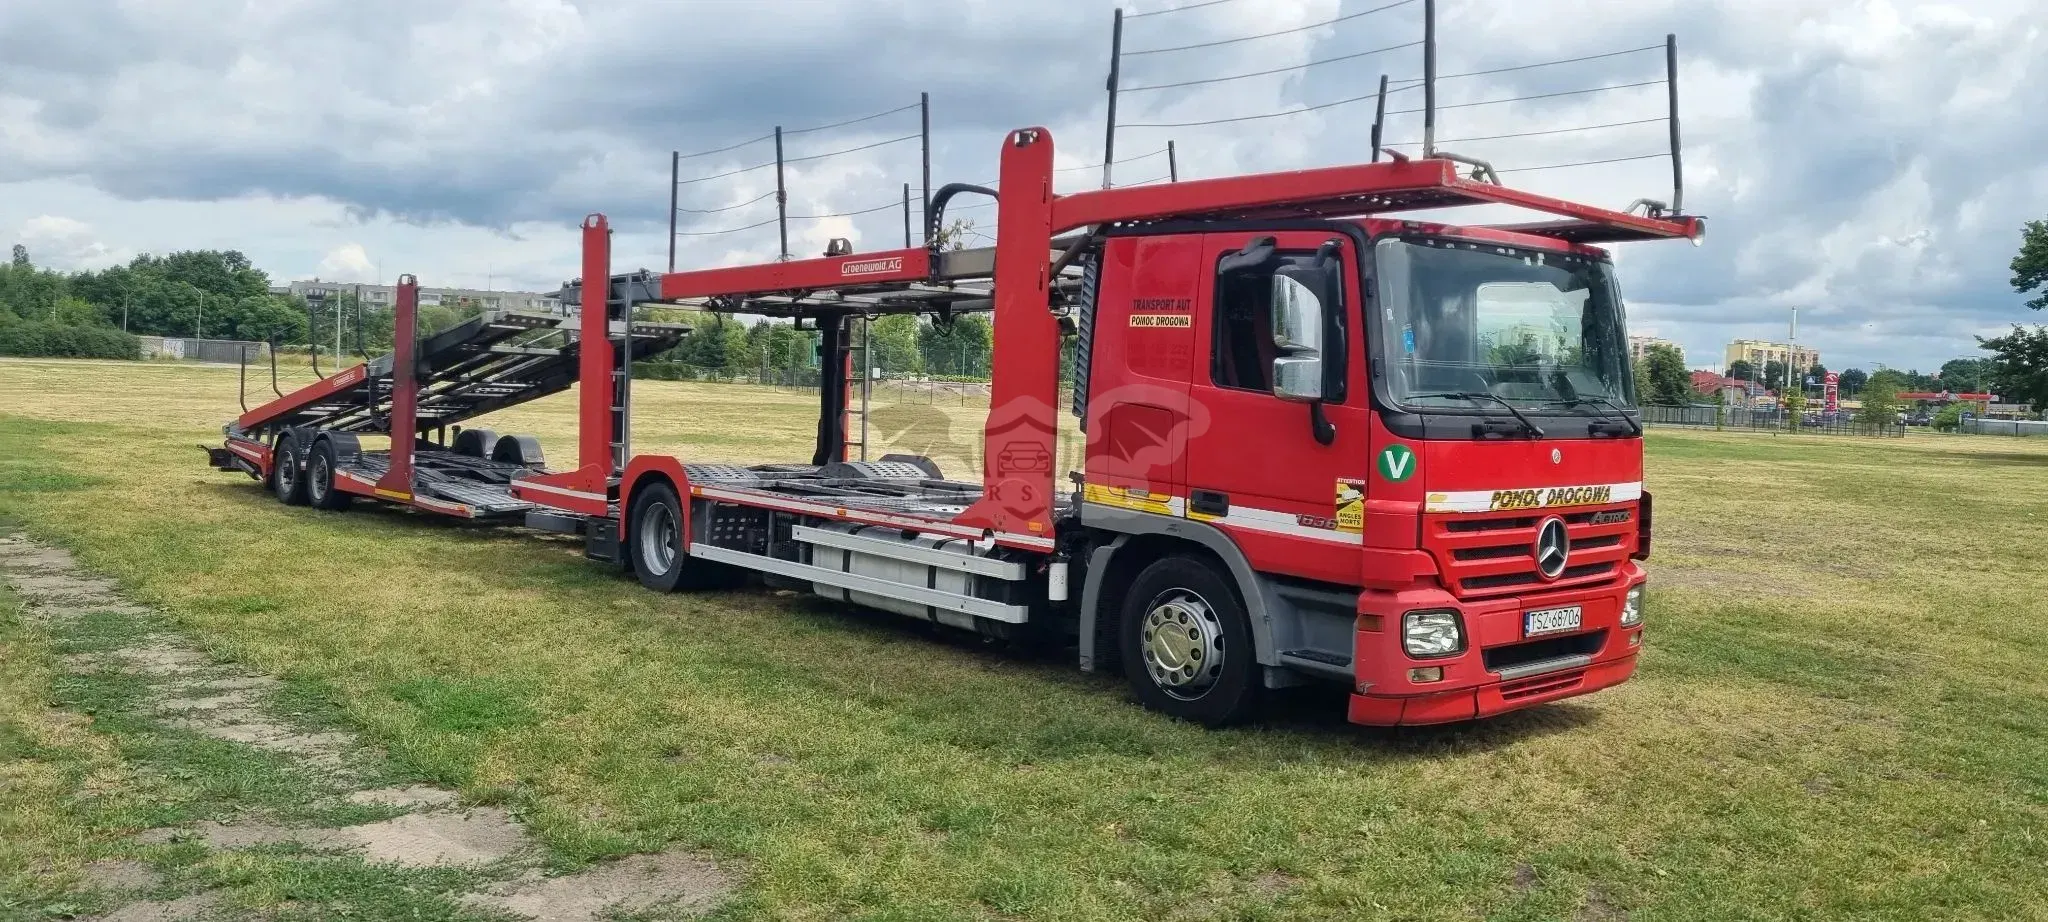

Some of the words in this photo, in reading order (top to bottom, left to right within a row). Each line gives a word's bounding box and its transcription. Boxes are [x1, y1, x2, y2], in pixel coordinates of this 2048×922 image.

[1132, 299, 1175, 311] TRANSPORT
[1177, 299, 1191, 311] AUT
[1131, 316, 1154, 326] POMOC
[1156, 316, 1189, 326] DROGOWA
[1385, 450, 1410, 478] V
[1336, 477, 1366, 485] ATTENTION
[1490, 490, 1544, 511] POMOC
[1545, 486, 1611, 505] DROGOWA
[1339, 512, 1361, 520] ANGLES
[1340, 518, 1360, 526] MORTS
